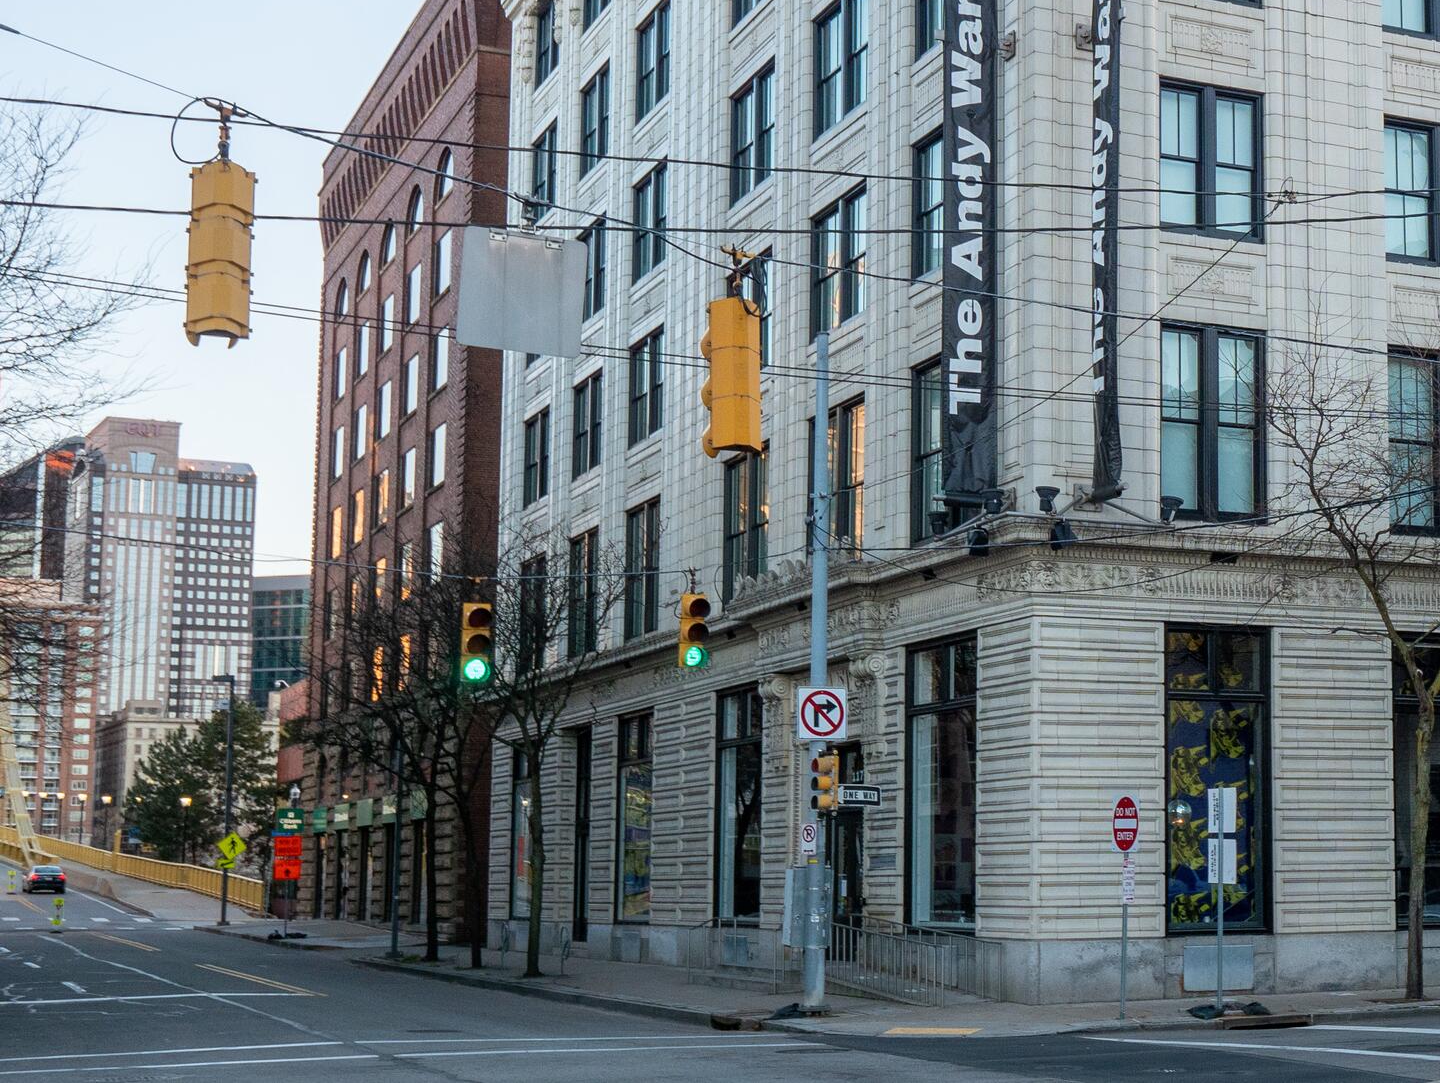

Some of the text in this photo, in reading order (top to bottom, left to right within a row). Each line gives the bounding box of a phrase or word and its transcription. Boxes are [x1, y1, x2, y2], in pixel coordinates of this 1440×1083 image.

[951, 125, 991, 282] Andy
[949, 298, 983, 415] The
[843, 791, 876, 800] ONE WAY
[1116, 807, 1136, 816] DO NOT
[1116, 831, 1134, 840] ENTER
